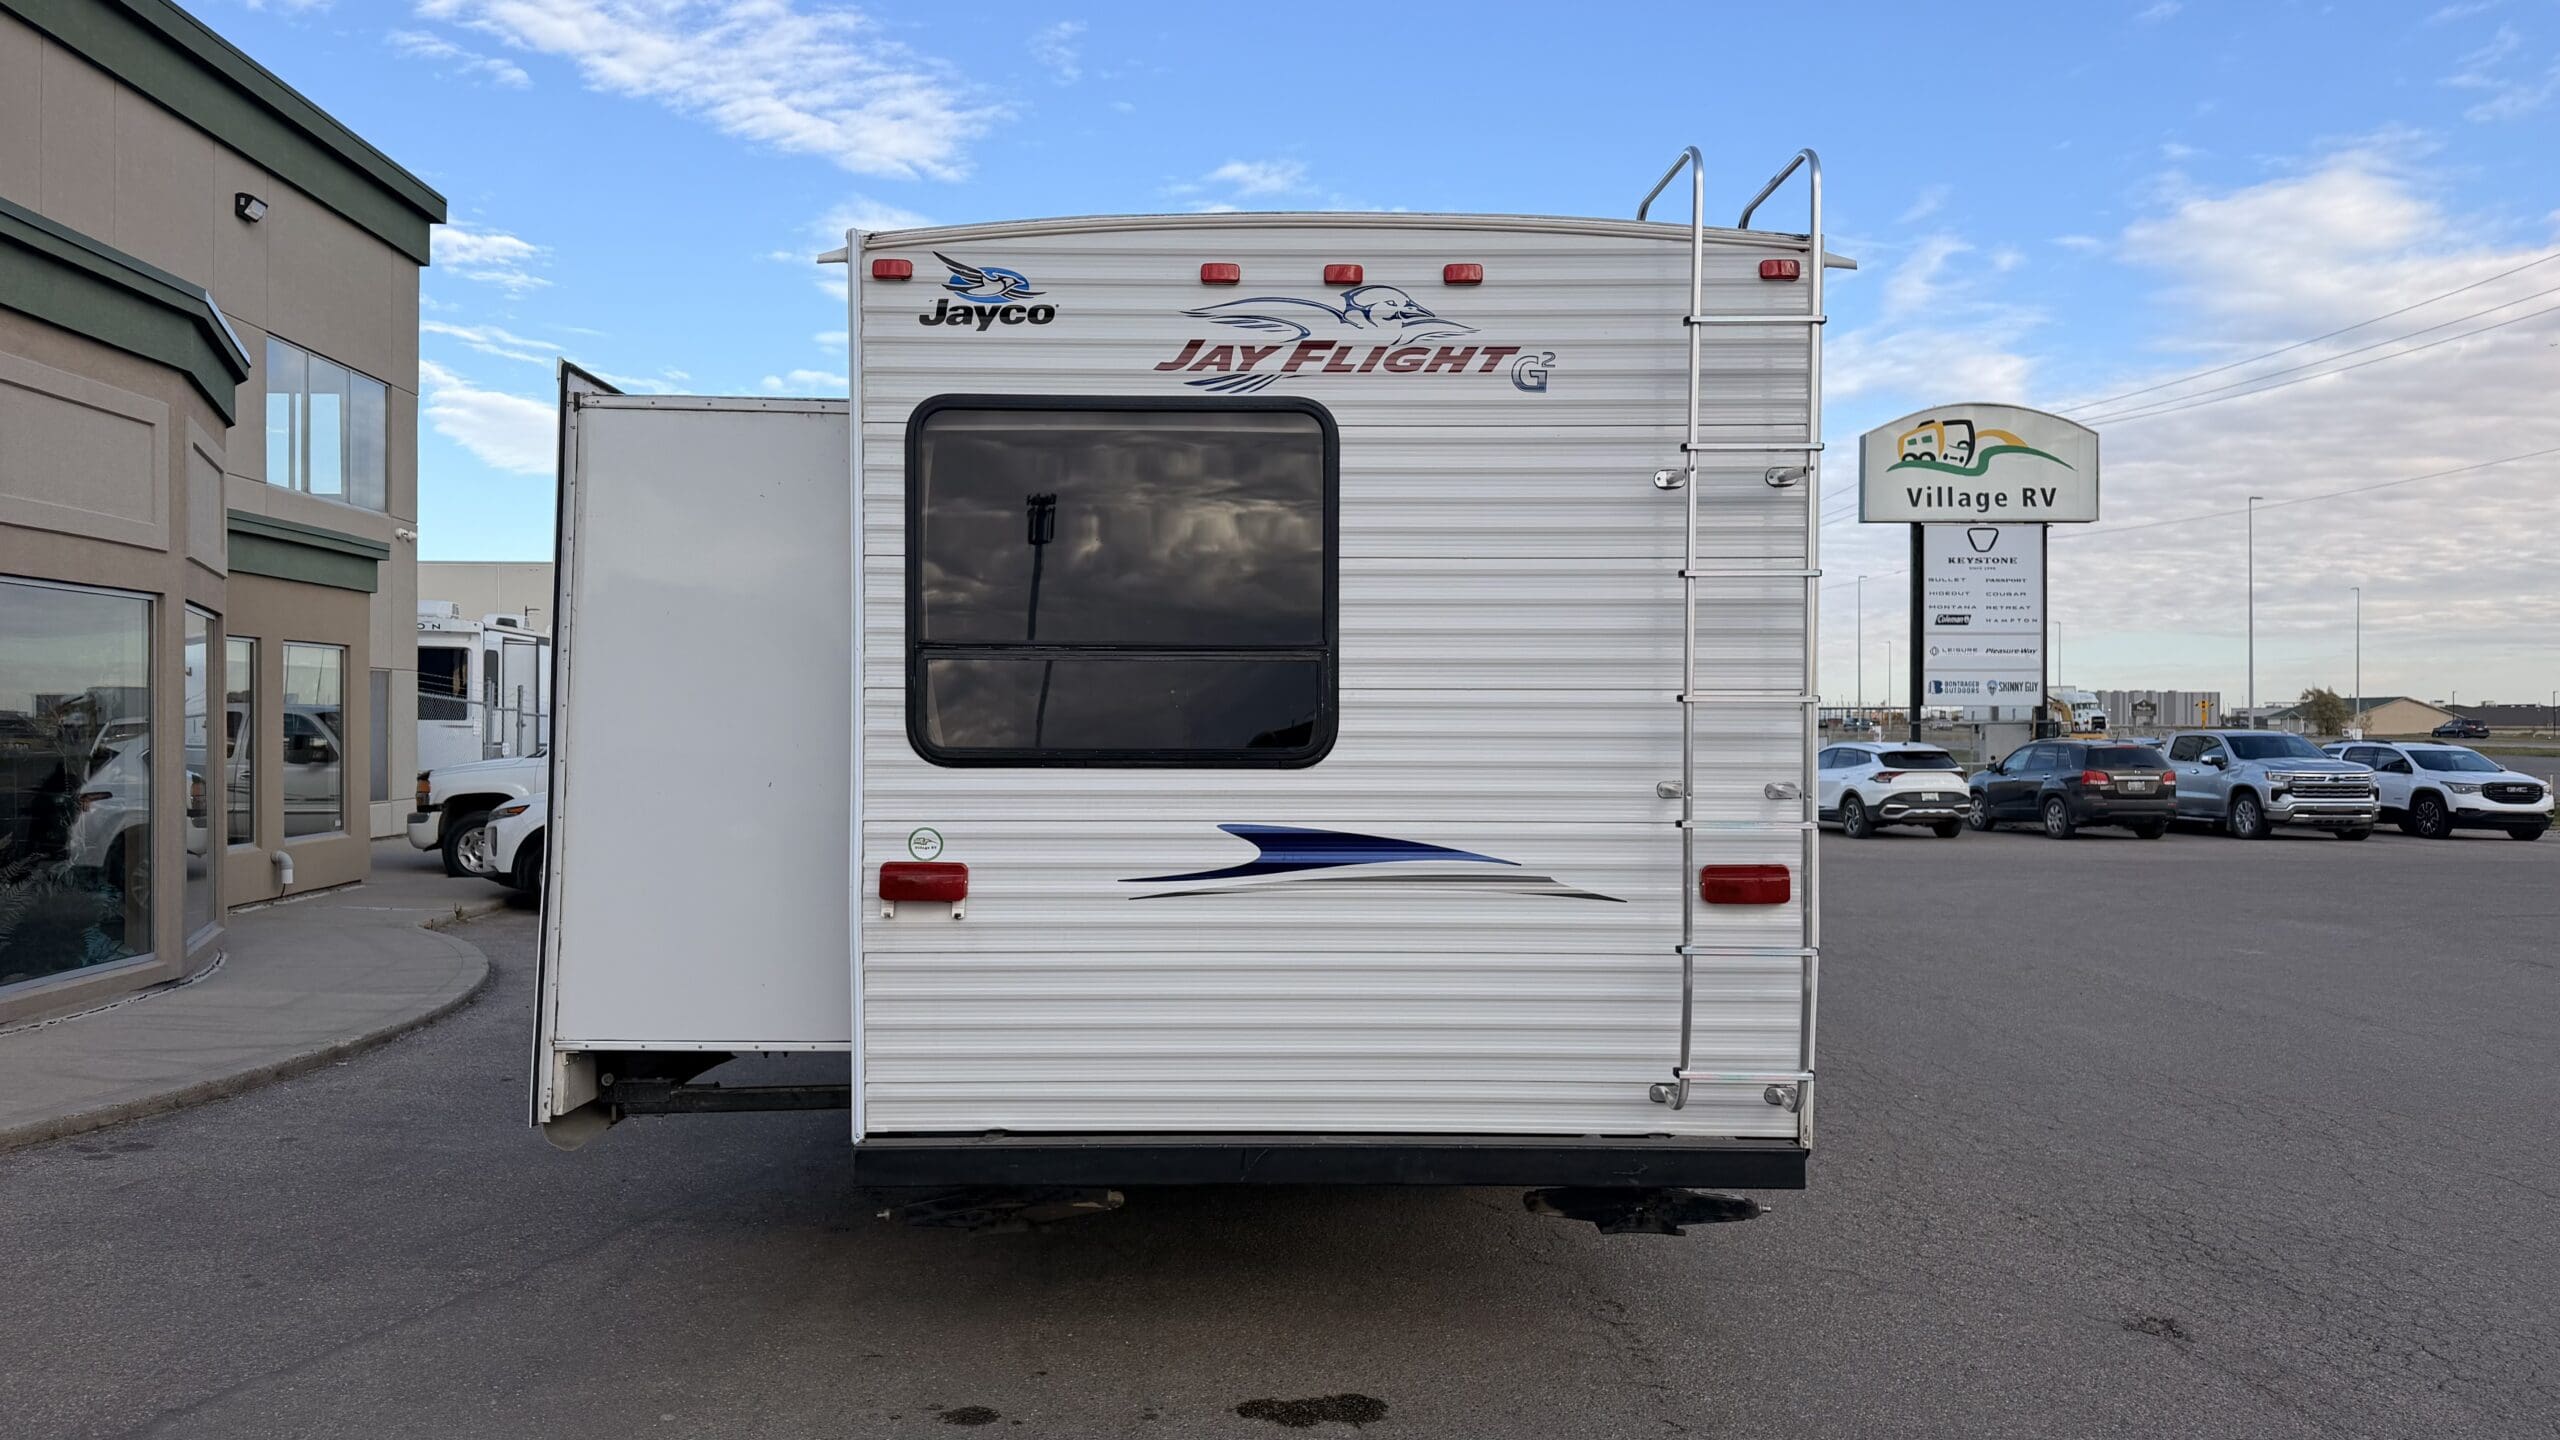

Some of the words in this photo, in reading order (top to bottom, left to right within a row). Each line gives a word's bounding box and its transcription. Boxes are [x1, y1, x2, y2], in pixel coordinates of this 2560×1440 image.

[919, 298, 1055, 331] Jayco
[1153, 339, 1283, 372] JAY
[1280, 339, 1521, 373] FLIGHT
[1906, 486, 2008, 513] Village
[2022, 487, 2057, 508] RV
[1998, 681, 2024, 692] SKINNY
[2025, 681, 2039, 692] GUY
